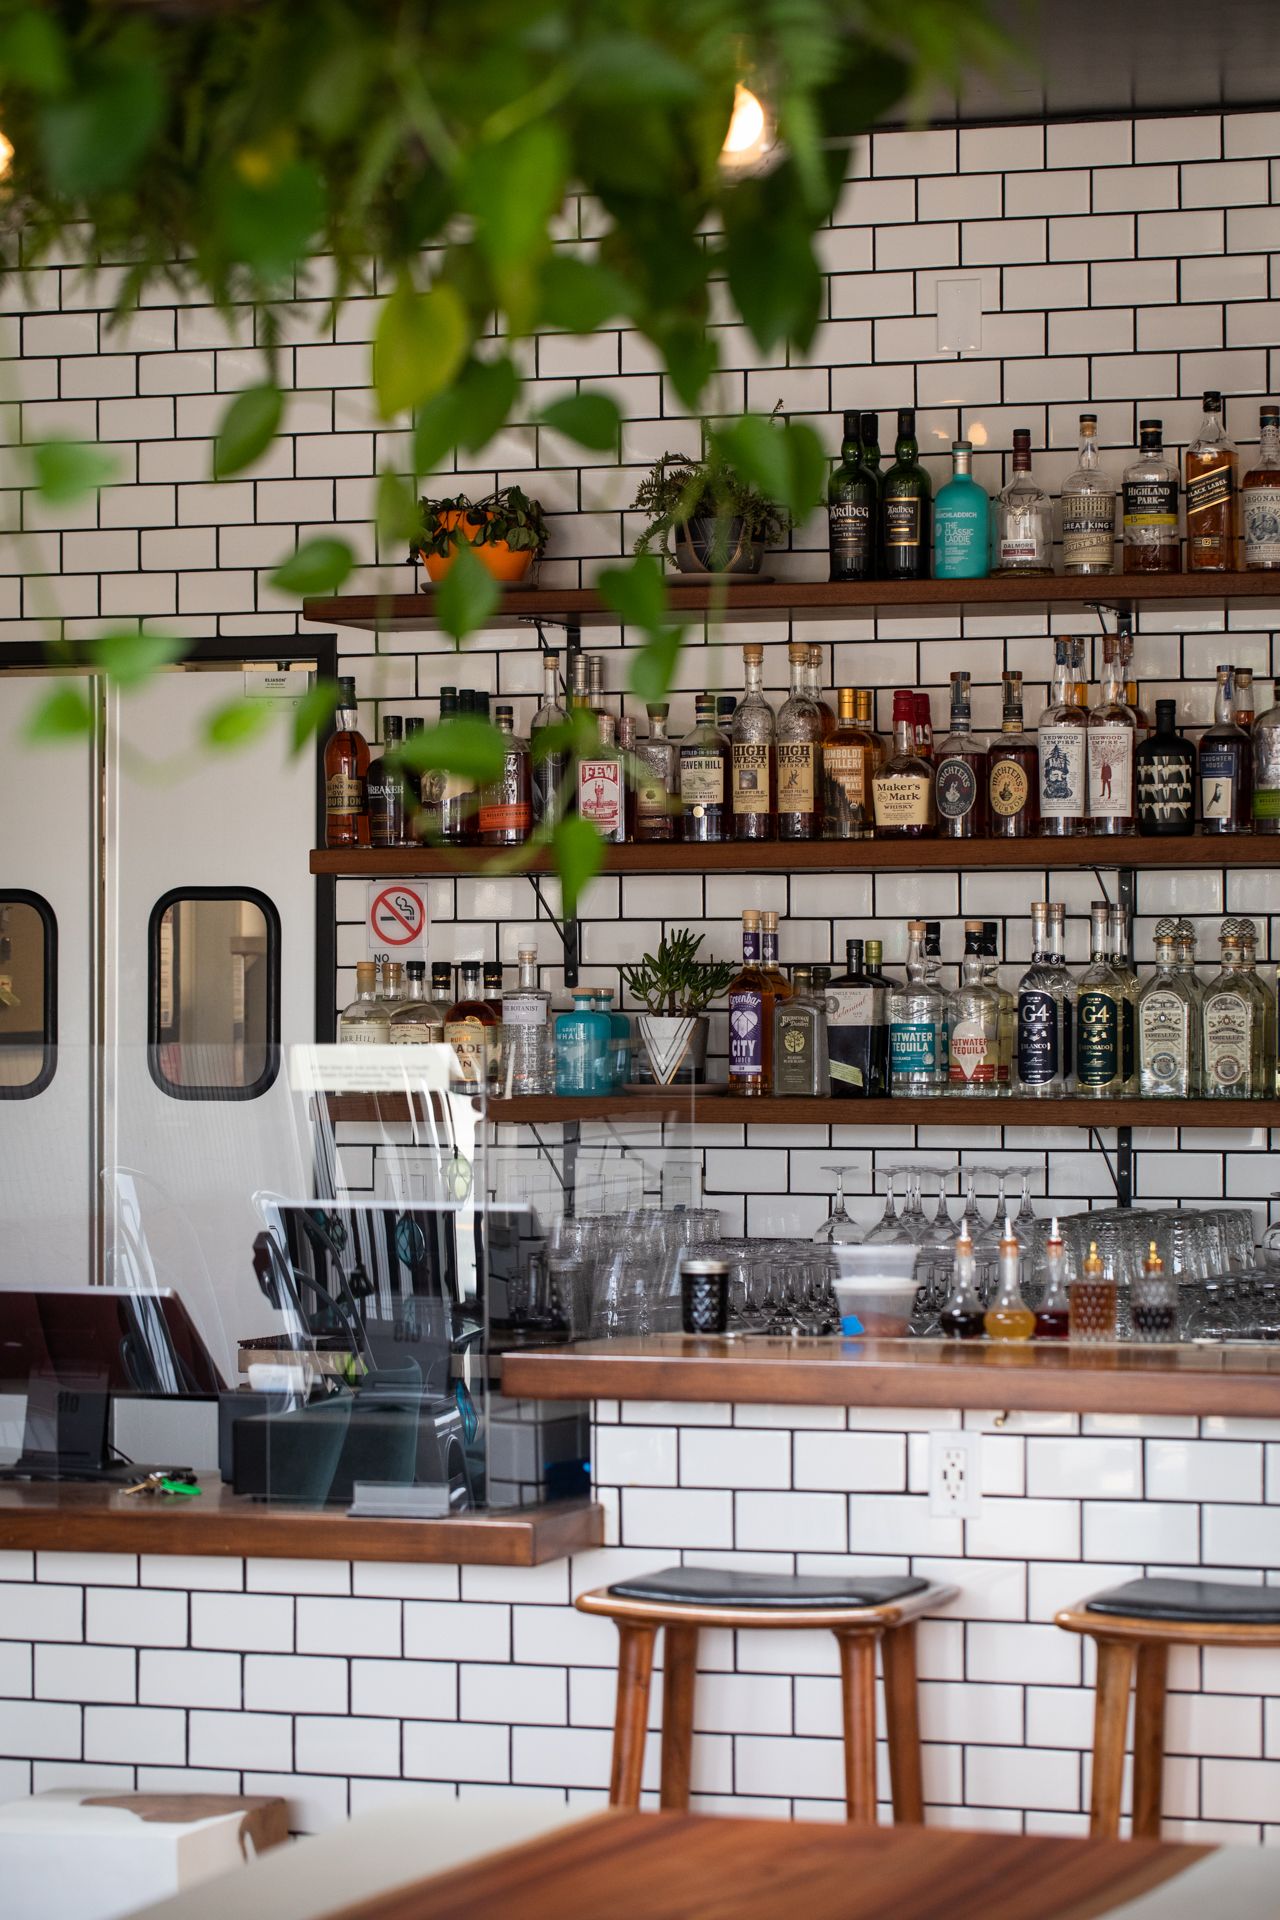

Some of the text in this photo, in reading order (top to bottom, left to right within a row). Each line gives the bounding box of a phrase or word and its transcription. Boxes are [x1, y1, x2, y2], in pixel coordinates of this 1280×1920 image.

[1208, 479, 1227, 490] LABEL
[734, 746, 766, 756] HIGH
[779, 746, 810, 756] HIGH
[705, 760, 721, 769] HILL
[734, 756, 766, 764] WEST
[585, 765, 614, 780] FEW
[374, 954, 389, 963] NO
[1022, 1004, 1049, 1022] G4
[1082, 1005, 1109, 1023] G4
[732, 1040, 756, 1056] CITY
[893, 1042, 928, 1053] TEQUILA
[954, 1046, 985, 1055] TEQUILA
